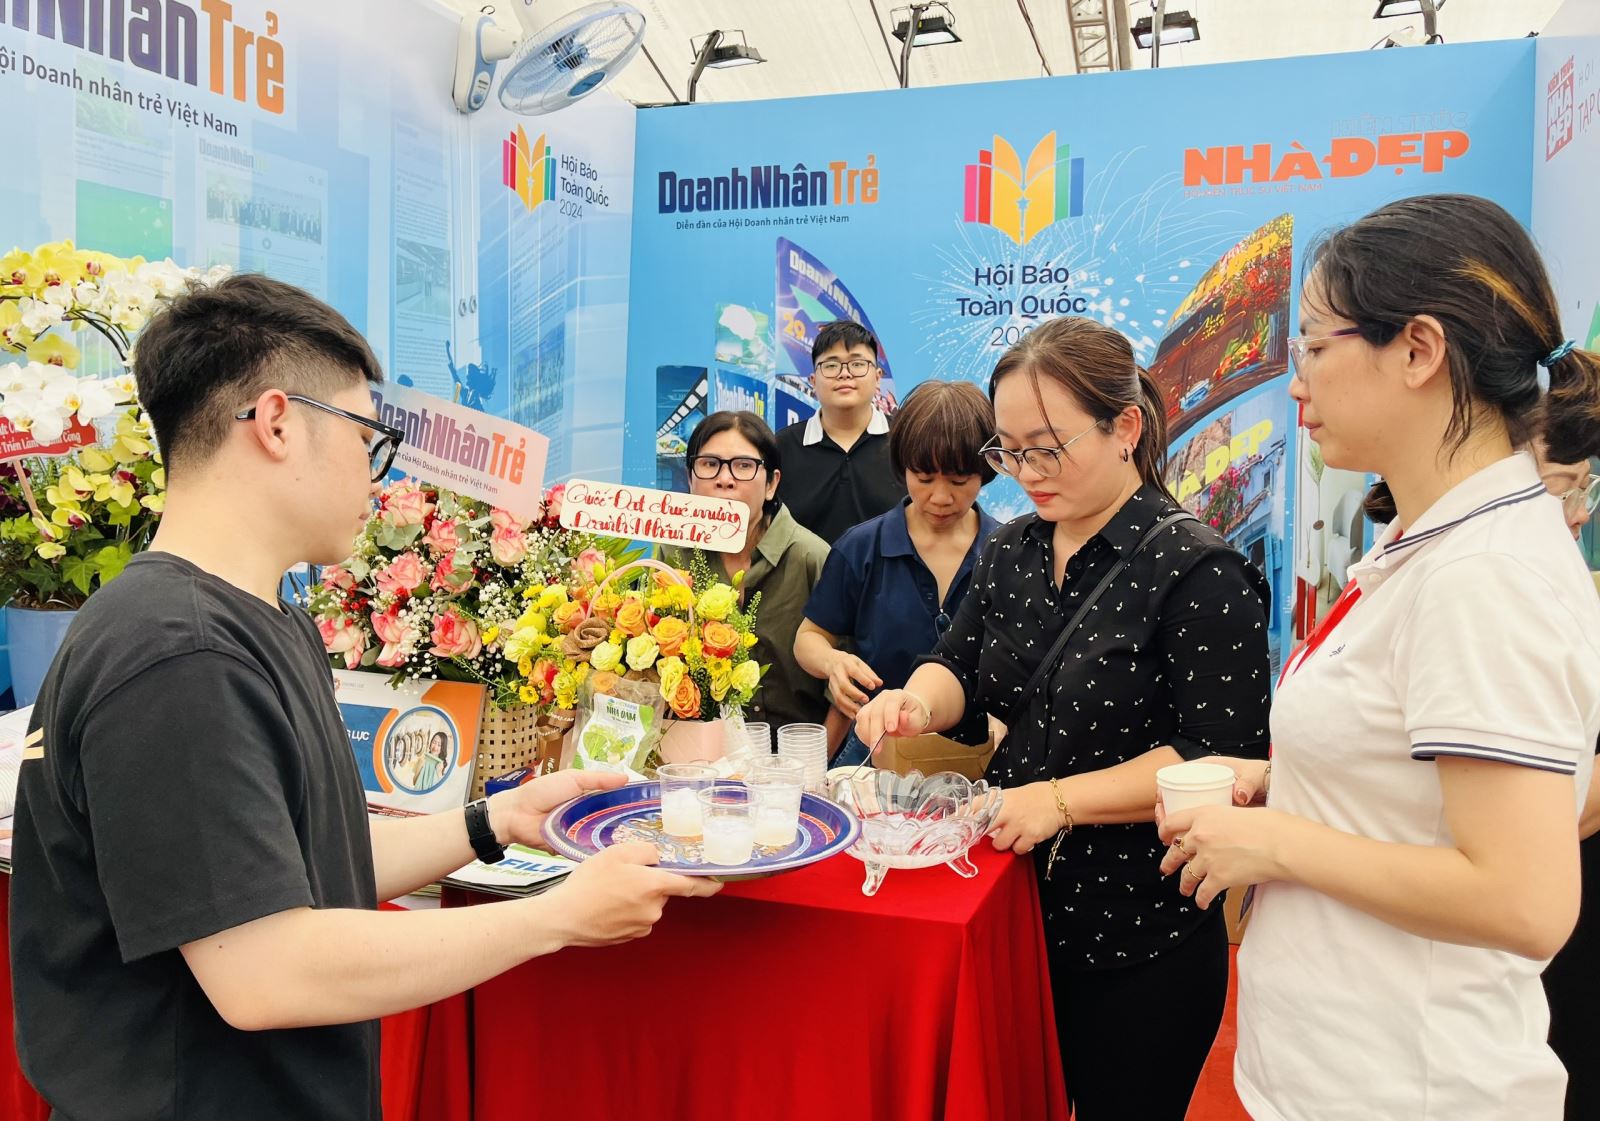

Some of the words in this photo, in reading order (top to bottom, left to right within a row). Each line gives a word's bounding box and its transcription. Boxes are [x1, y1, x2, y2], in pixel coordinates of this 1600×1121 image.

[0, 46, 15, 74] ội
[23, 55, 82, 90] Doanh
[89, 77, 133, 106] nhân
[138, 92, 162, 114] trẻ
[167, 98, 199, 128] Việt
[204, 111, 237, 137] Nam
[561, 154, 578, 176] Hội
[580, 163, 598, 181] Báo
[561, 176, 584, 198] Toàn
[585, 185, 609, 207] Quốc
[560, 198, 583, 219] 2024
[728, 218, 742, 229] Hội
[744, 216, 771, 227] Doanh
[773, 216, 794, 226] nhân
[796, 214, 808, 224] trẻ
[810, 214, 828, 226] Việt
[829, 214, 850, 223] Nam
[974, 263, 1014, 291] Hội
[1021, 261, 1070, 284] Báo
[956, 294, 1013, 317] Toàn
[1021, 285, 1087, 319] Quốc
[991, 326, 1033, 346] 20
[422, 460, 440, 474] Doanh
[483, 483, 499, 494] Nam
